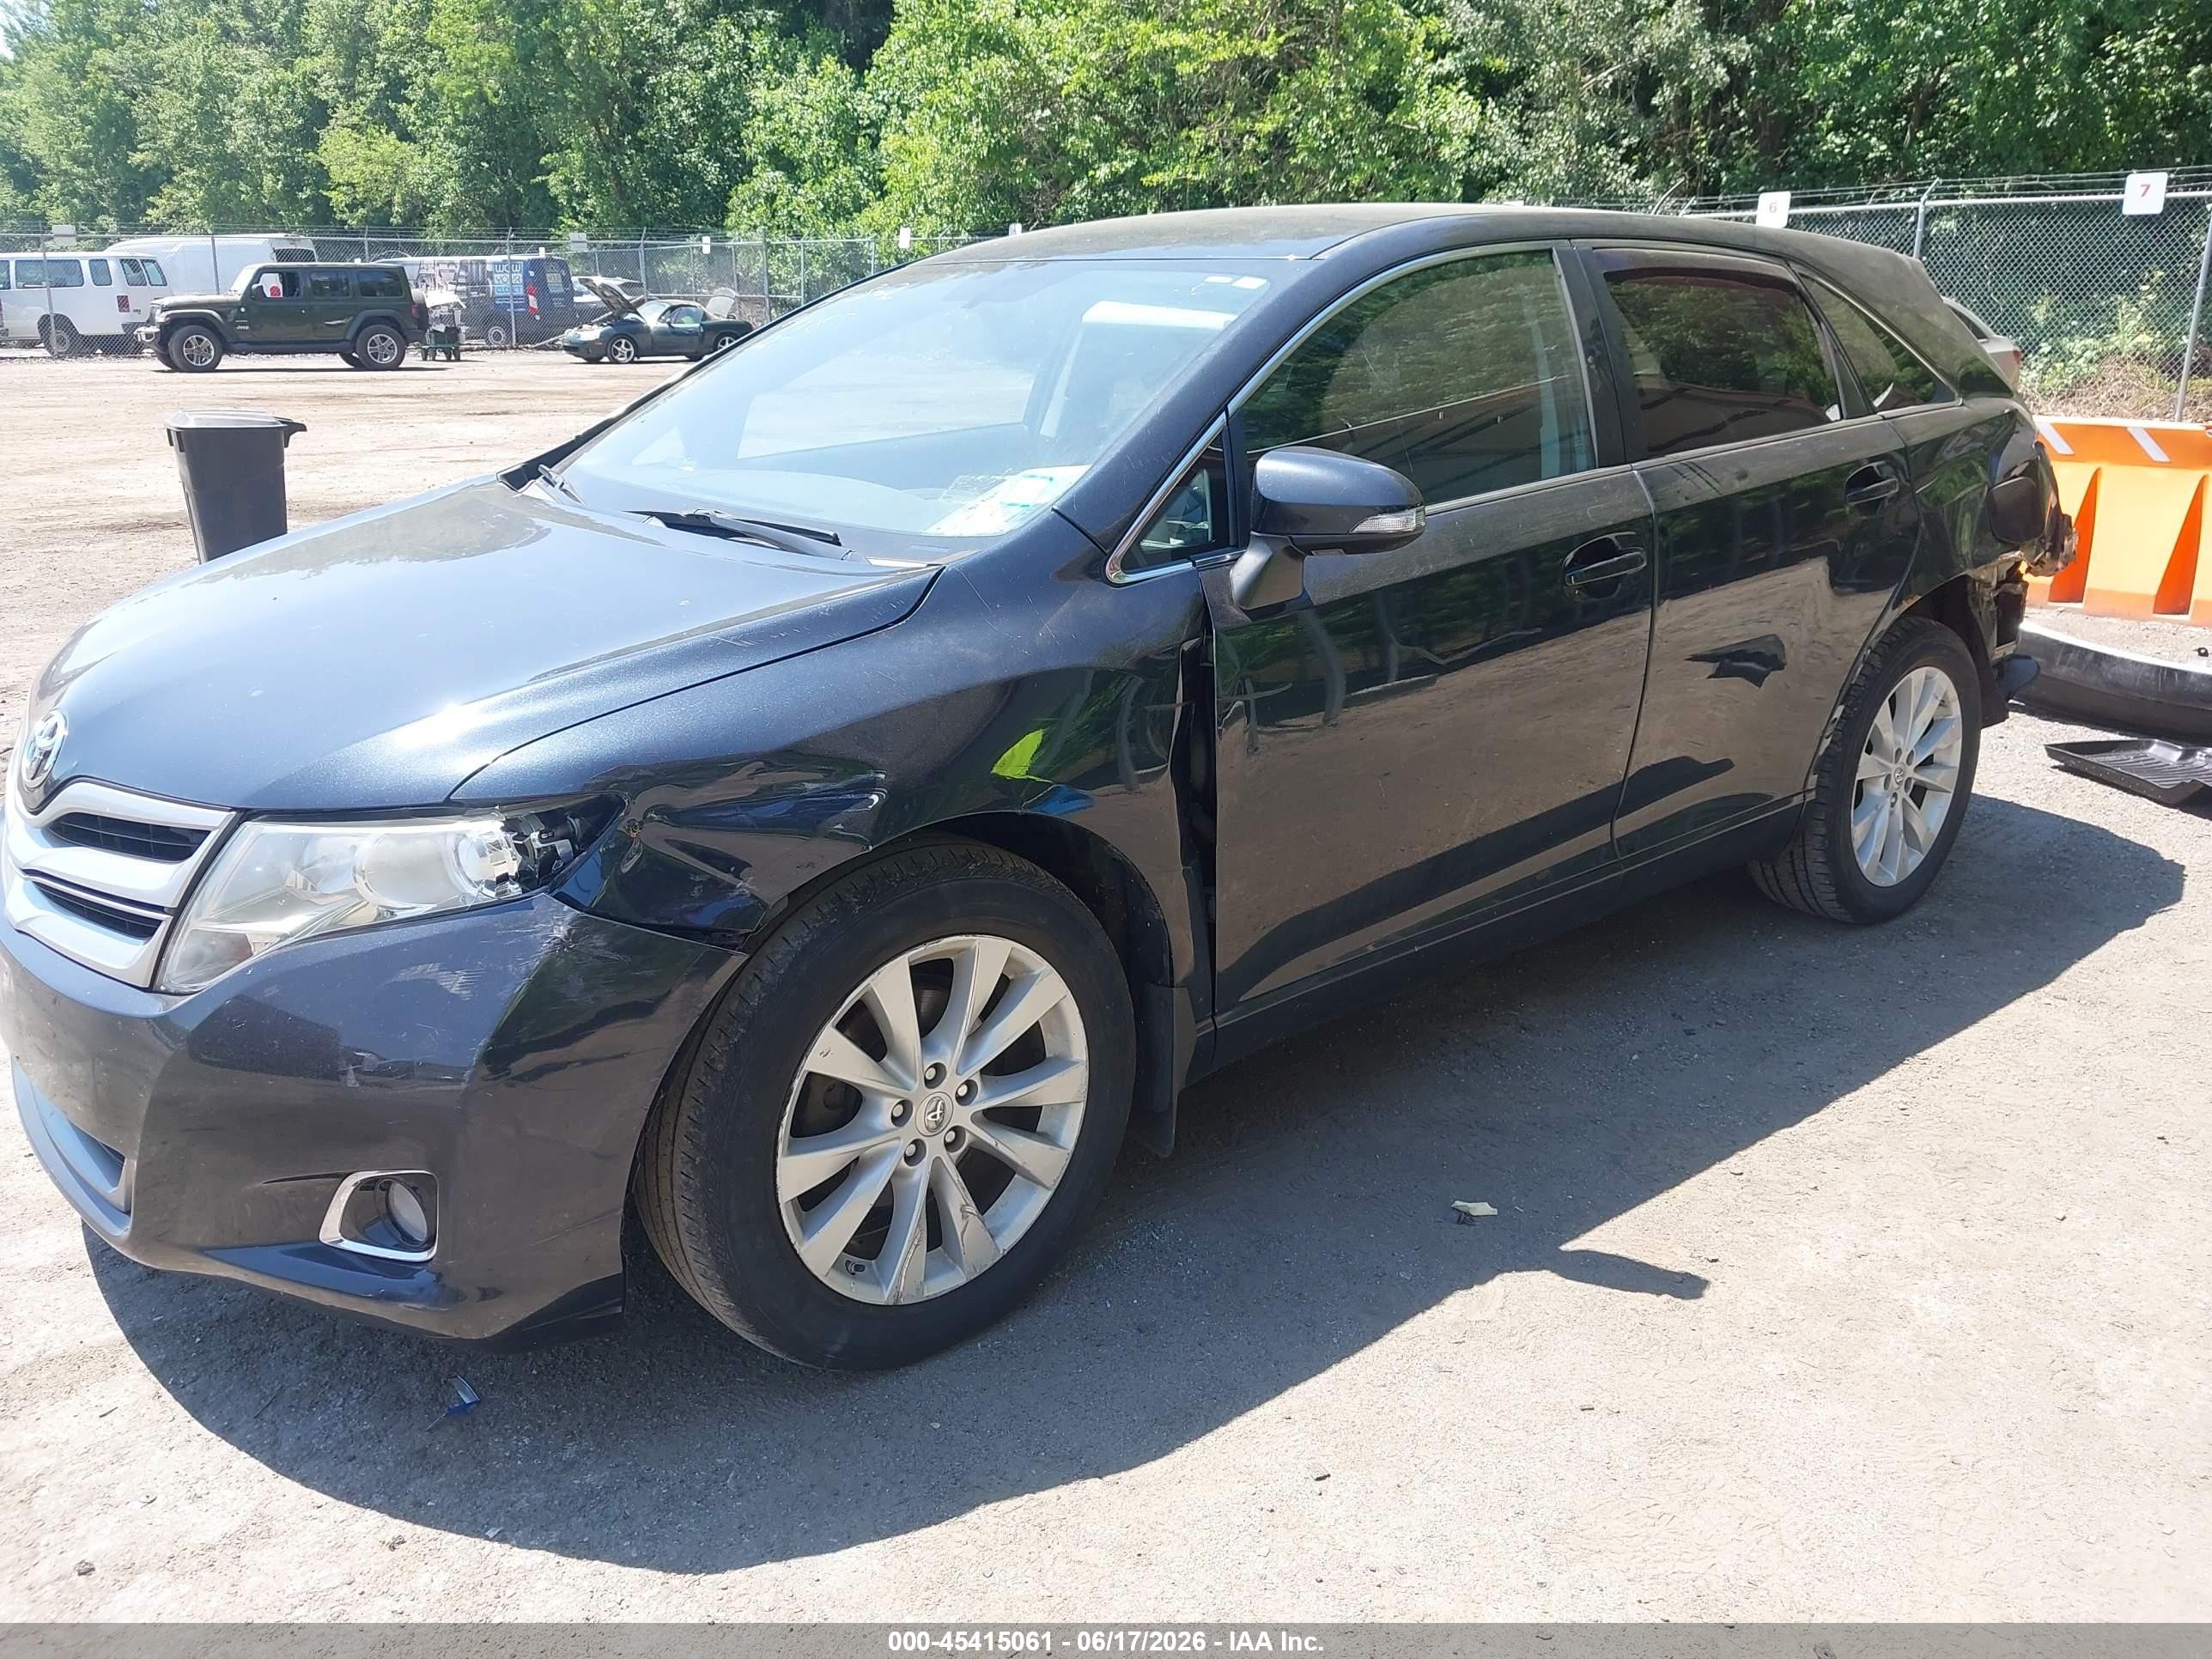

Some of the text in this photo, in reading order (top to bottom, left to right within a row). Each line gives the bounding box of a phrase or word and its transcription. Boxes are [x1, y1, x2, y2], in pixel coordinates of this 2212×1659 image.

[2141, 184, 2150, 198] 7
[1769, 202, 1778, 214] 6
[495, 264, 521, 273] WOW
